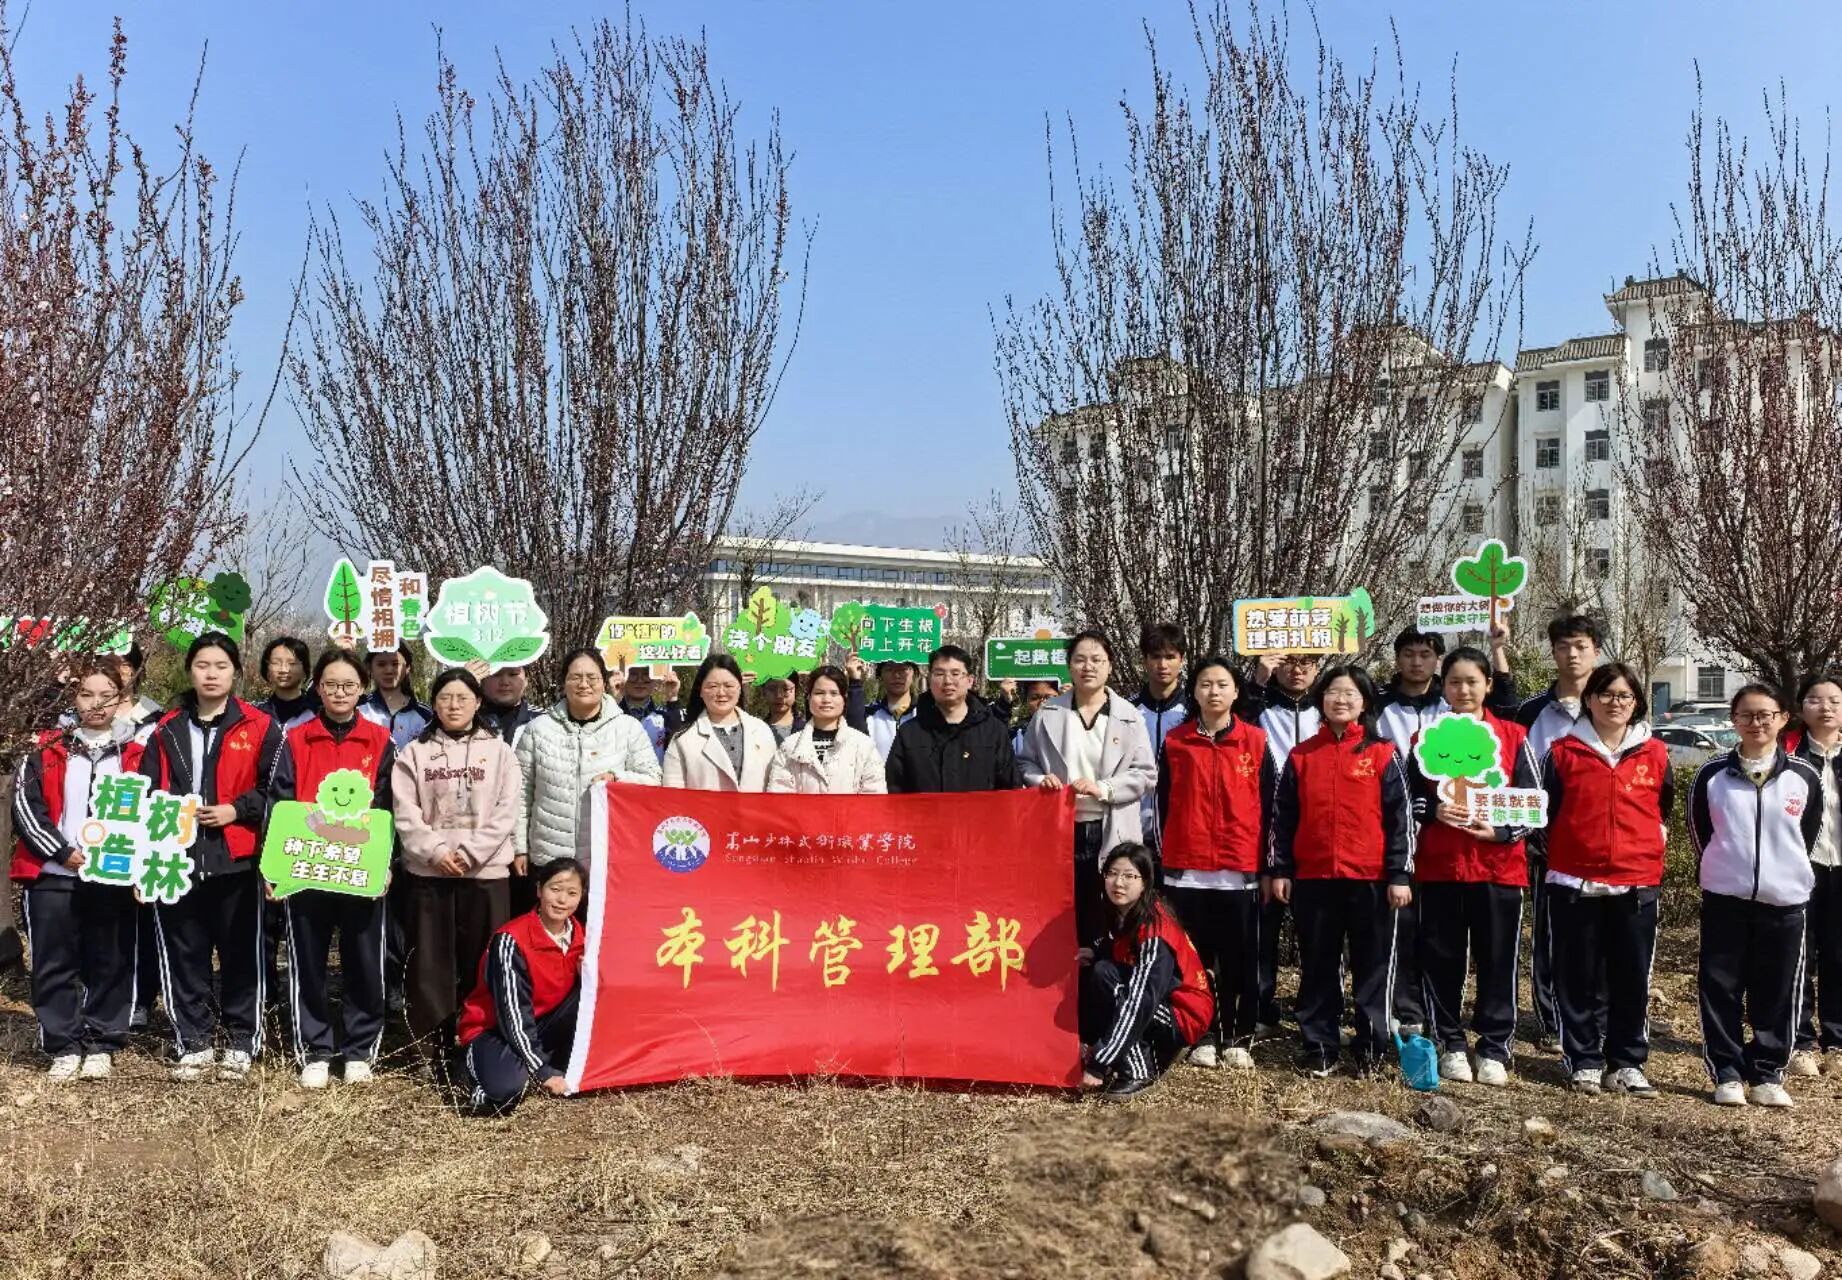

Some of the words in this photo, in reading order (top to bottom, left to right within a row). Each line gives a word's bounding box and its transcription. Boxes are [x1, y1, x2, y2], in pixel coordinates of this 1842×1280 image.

[370, 565, 395, 649] 尽情相拥
[399, 577, 422, 638] 和春色
[447, 600, 530, 627] 植树节
[1246, 608, 1333, 630] 热爱萌芽
[860, 617, 935, 633] 向下生根
[1246, 628, 1333, 650] 理想扎根
[639, 644, 703, 660] 这么好看
[727, 628, 818, 658] 浇个朋友
[860, 637, 935, 653] 向上开花
[93, 774, 197, 845] 植树
[1475, 808, 1542, 823] 在你手里
[283, 836, 362, 865] 种下希望
[83, 832, 190, 900] 造林
[291, 860, 369, 888] 生生不息
[655, 906, 1026, 993] 本科管理部
